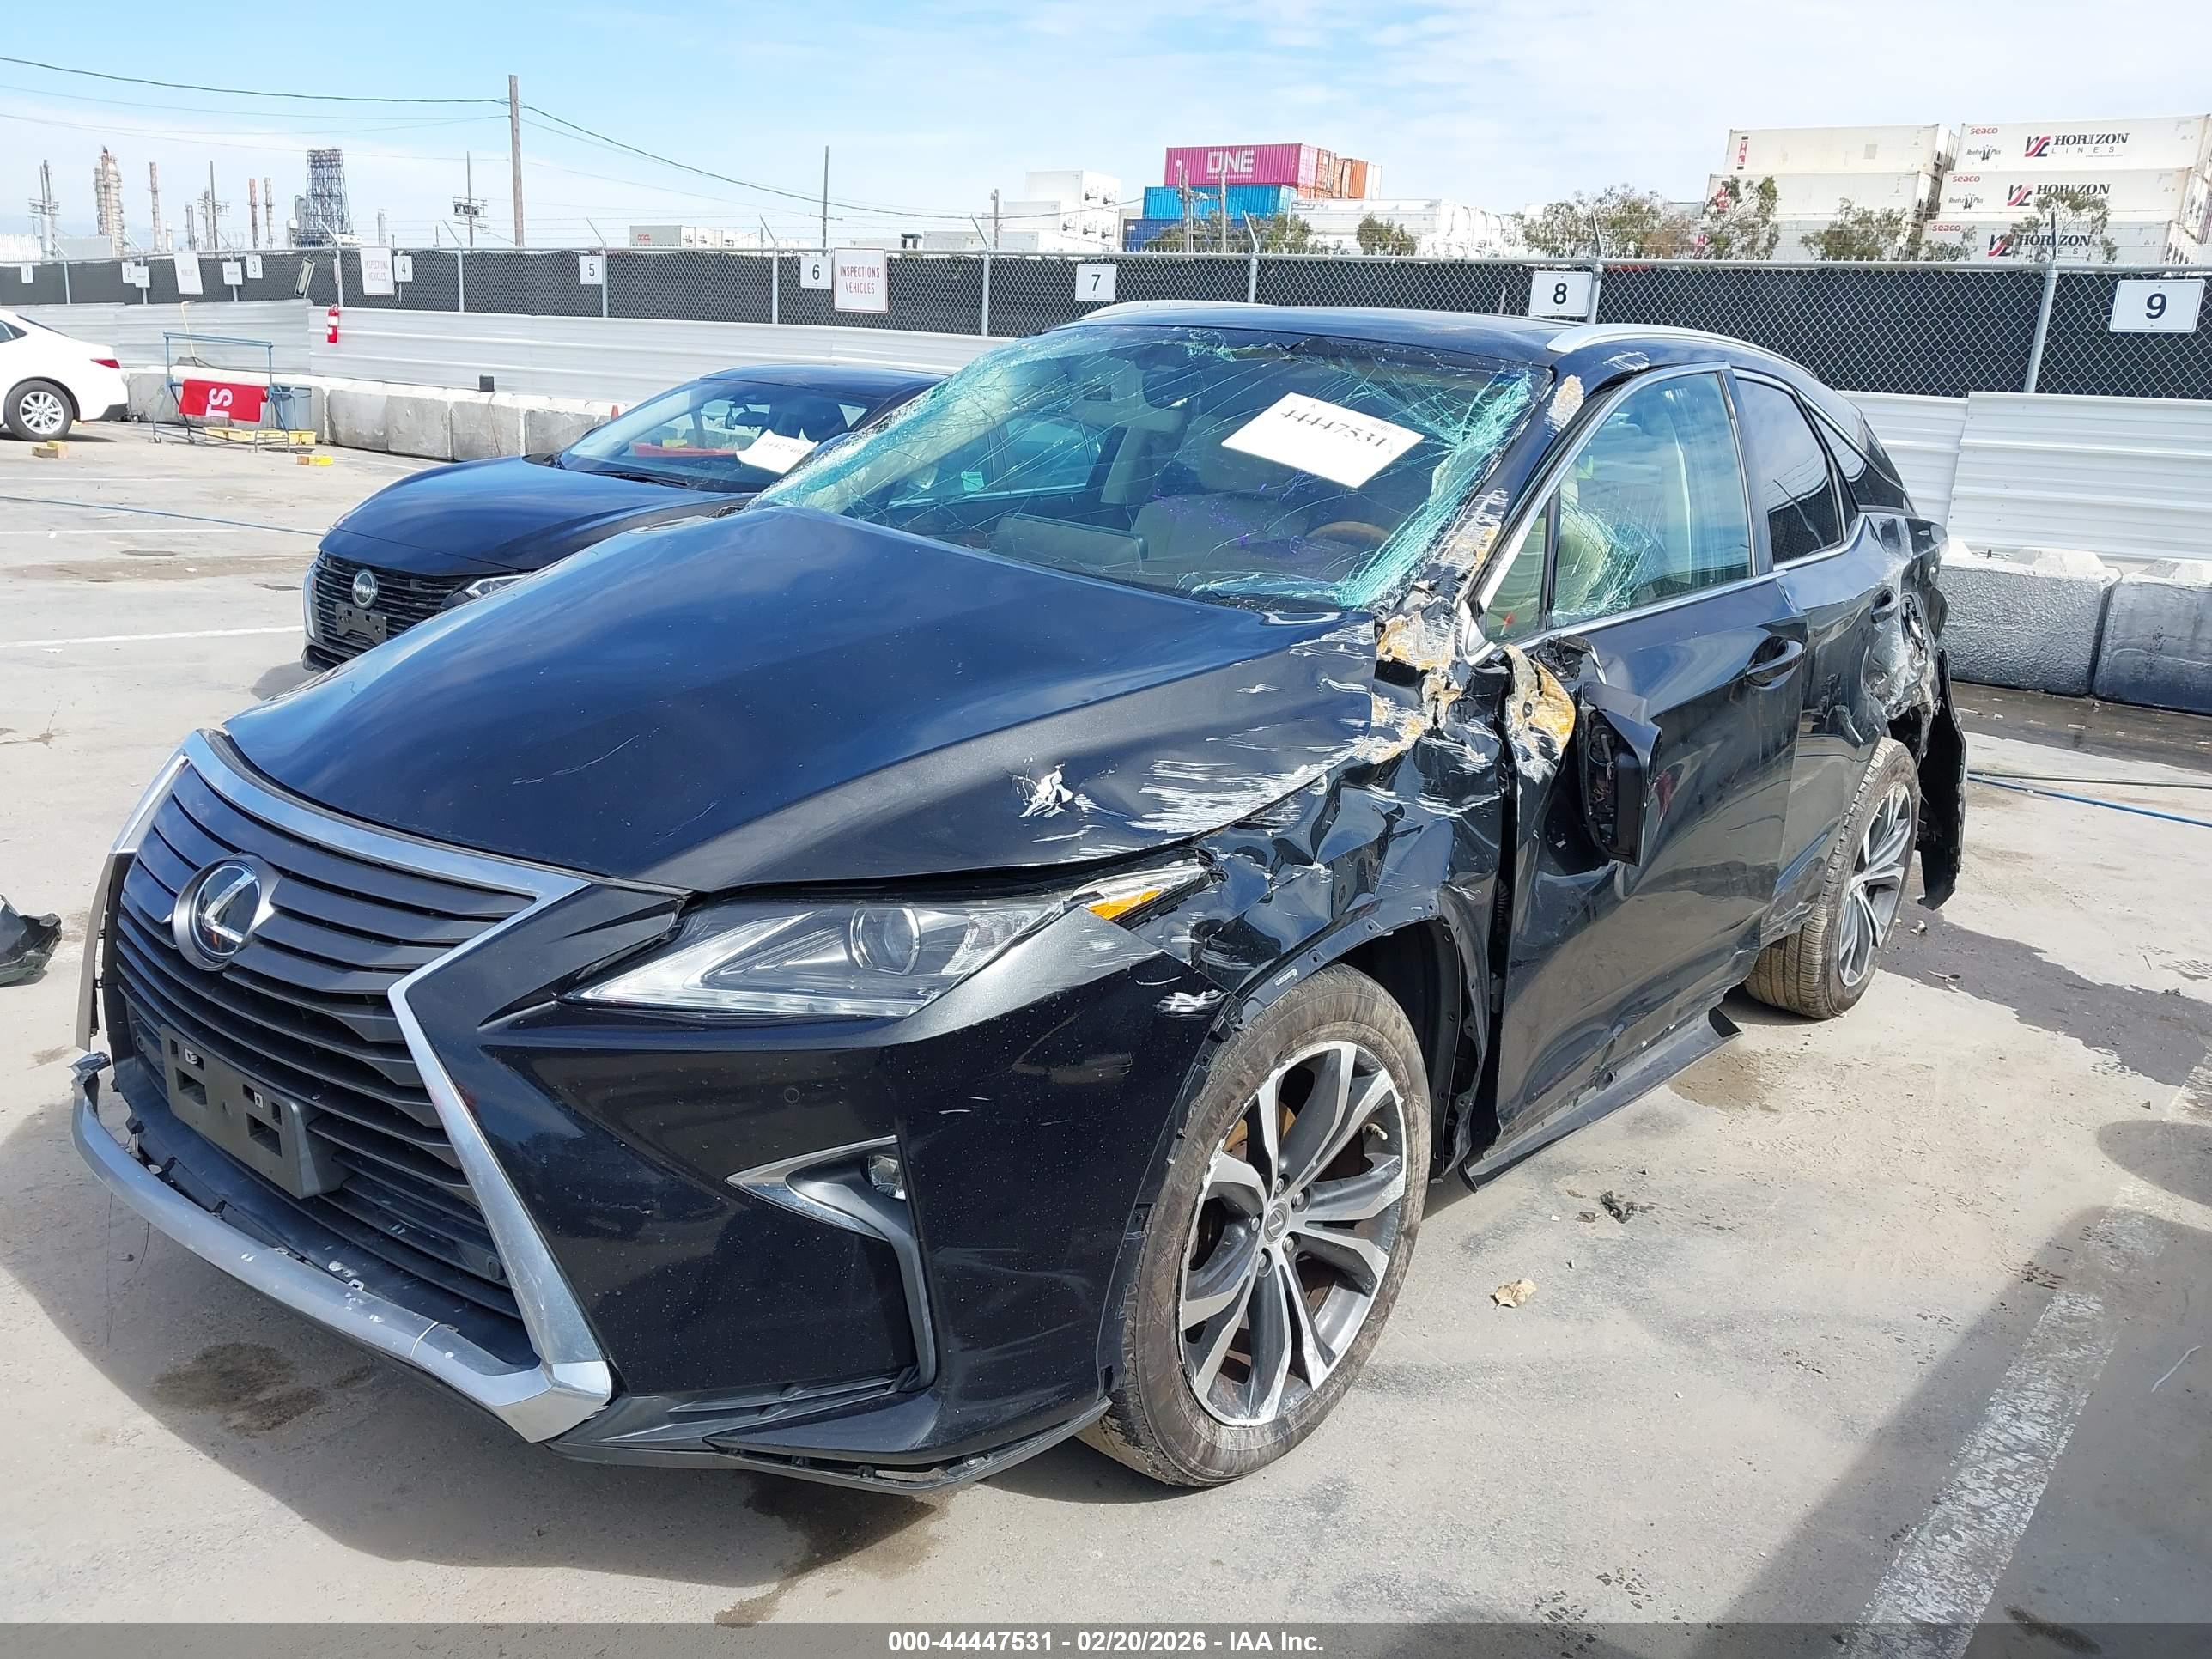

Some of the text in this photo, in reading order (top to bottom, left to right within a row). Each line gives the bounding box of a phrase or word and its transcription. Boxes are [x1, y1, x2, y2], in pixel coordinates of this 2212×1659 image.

[1970, 126, 1998, 135] seaco
[2053, 132, 2130, 145] HORIZON
[2051, 146, 2115, 155] LINES
[1206, 150, 1254, 173] ONE
[2019, 234, 2092, 246] HORZON
[127, 267, 131, 277] 2
[252, 260, 257, 272] 3
[402, 262, 406, 275] 4
[588, 263, 595, 276] 5
[812, 264, 820, 280] 6
[840, 265, 880, 279] INSPECTIONS
[845, 282, 875, 295] VEHICLES
[1091, 274, 1101, 292] 7
[1553, 283, 1568, 305] 8
[2145, 293, 2167, 319] 9
